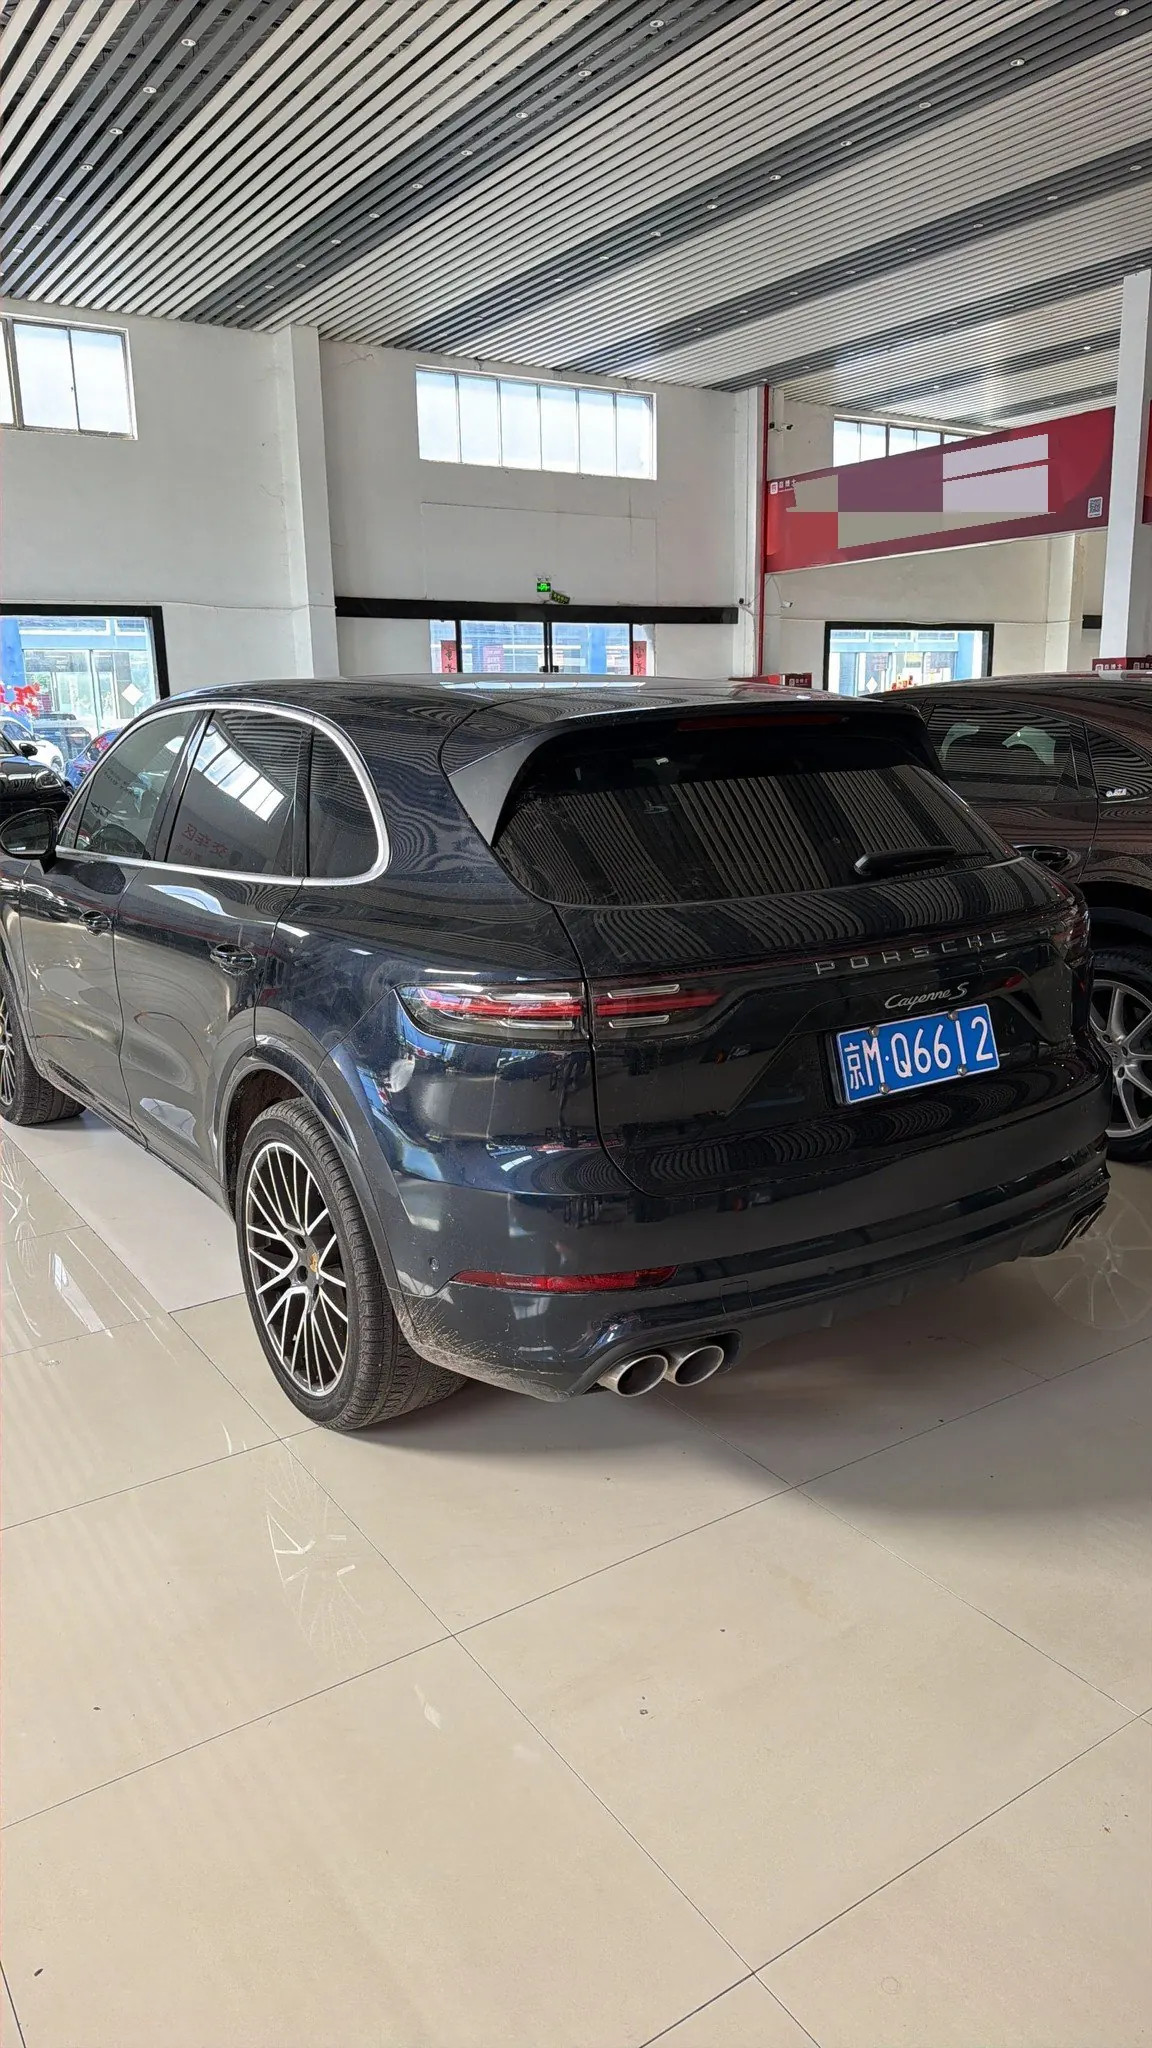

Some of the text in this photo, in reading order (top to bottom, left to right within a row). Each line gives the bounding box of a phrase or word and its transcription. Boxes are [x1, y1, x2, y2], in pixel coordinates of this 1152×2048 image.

[815, 931, 1007, 975] PORSCHE
[884, 982, 970, 1012] Cayenne S
